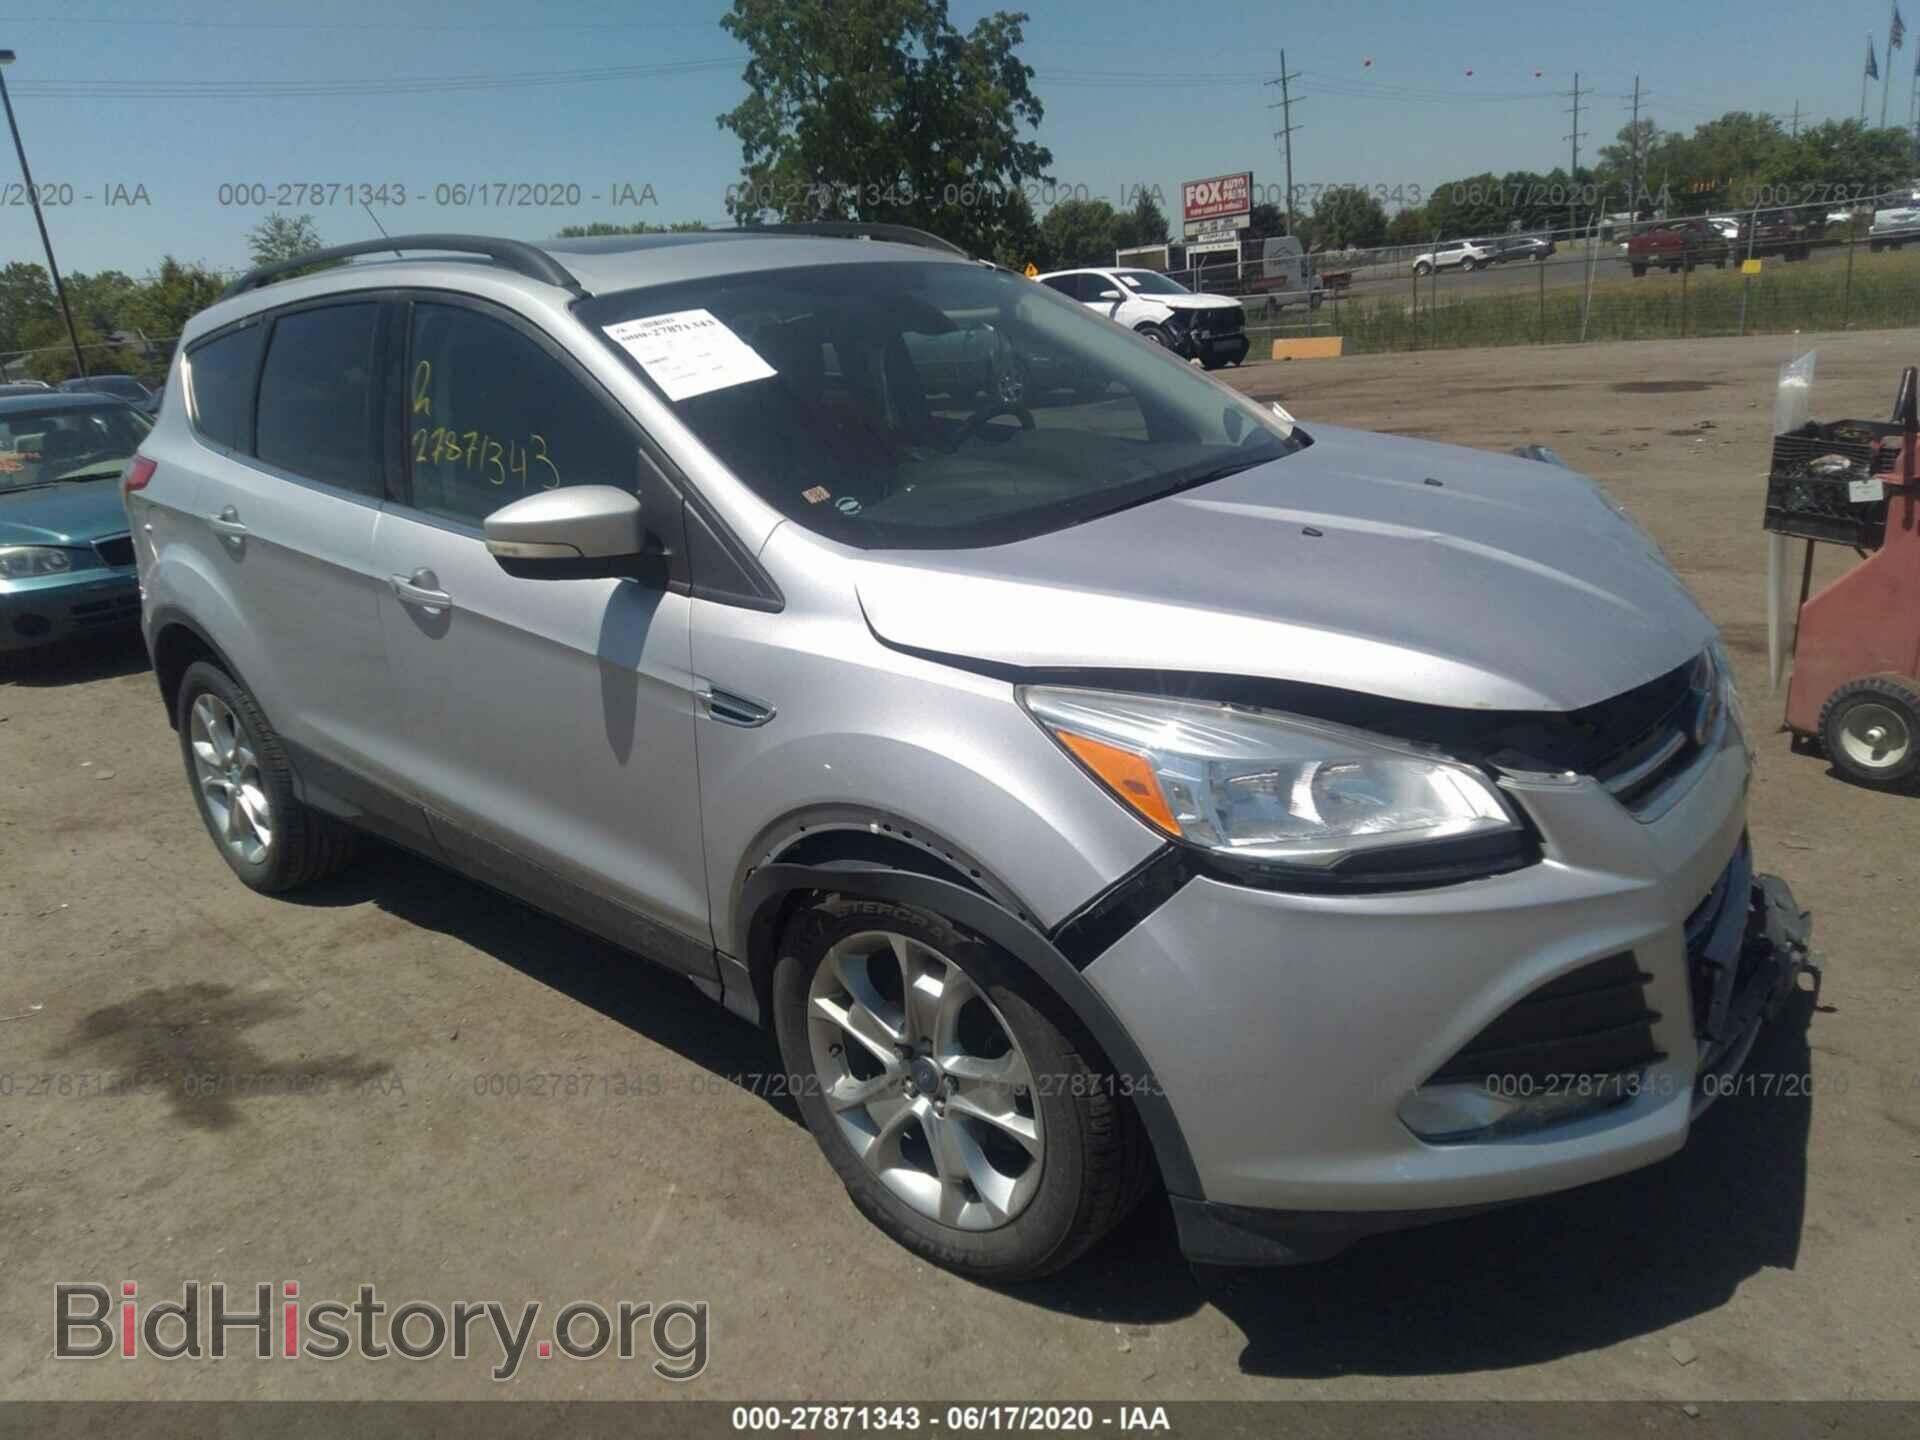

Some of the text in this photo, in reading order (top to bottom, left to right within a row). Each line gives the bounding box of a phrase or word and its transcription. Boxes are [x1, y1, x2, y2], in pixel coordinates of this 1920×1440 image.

[1186, 177, 1245, 207] FOX AUTO
[411, 427, 561, 489] 27871343
